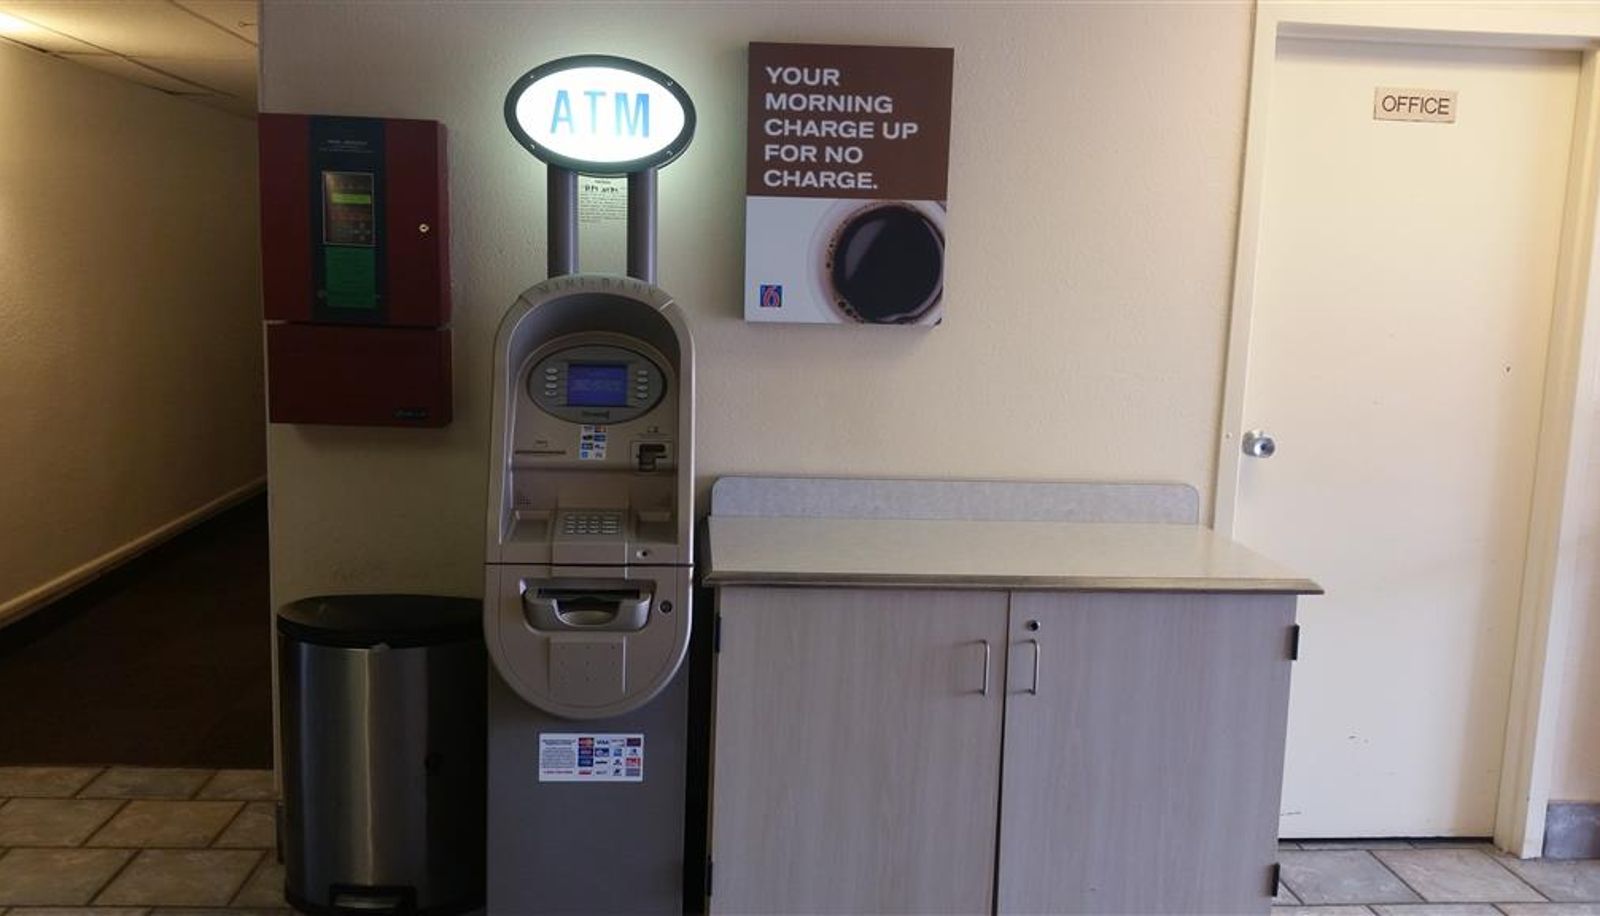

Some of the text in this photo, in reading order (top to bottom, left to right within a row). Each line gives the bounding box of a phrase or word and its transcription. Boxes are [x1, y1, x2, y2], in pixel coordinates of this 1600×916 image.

[765, 66, 840, 86] YOUR
[765, 92, 894, 114] MORNING
[1381, 94, 1451, 115] OFFICE
[550, 90, 650, 138] ATM
[764, 118, 919, 140] CHARGE UP
[764, 144, 864, 164] FOR NO
[763, 169, 878, 190] CHARGE.
